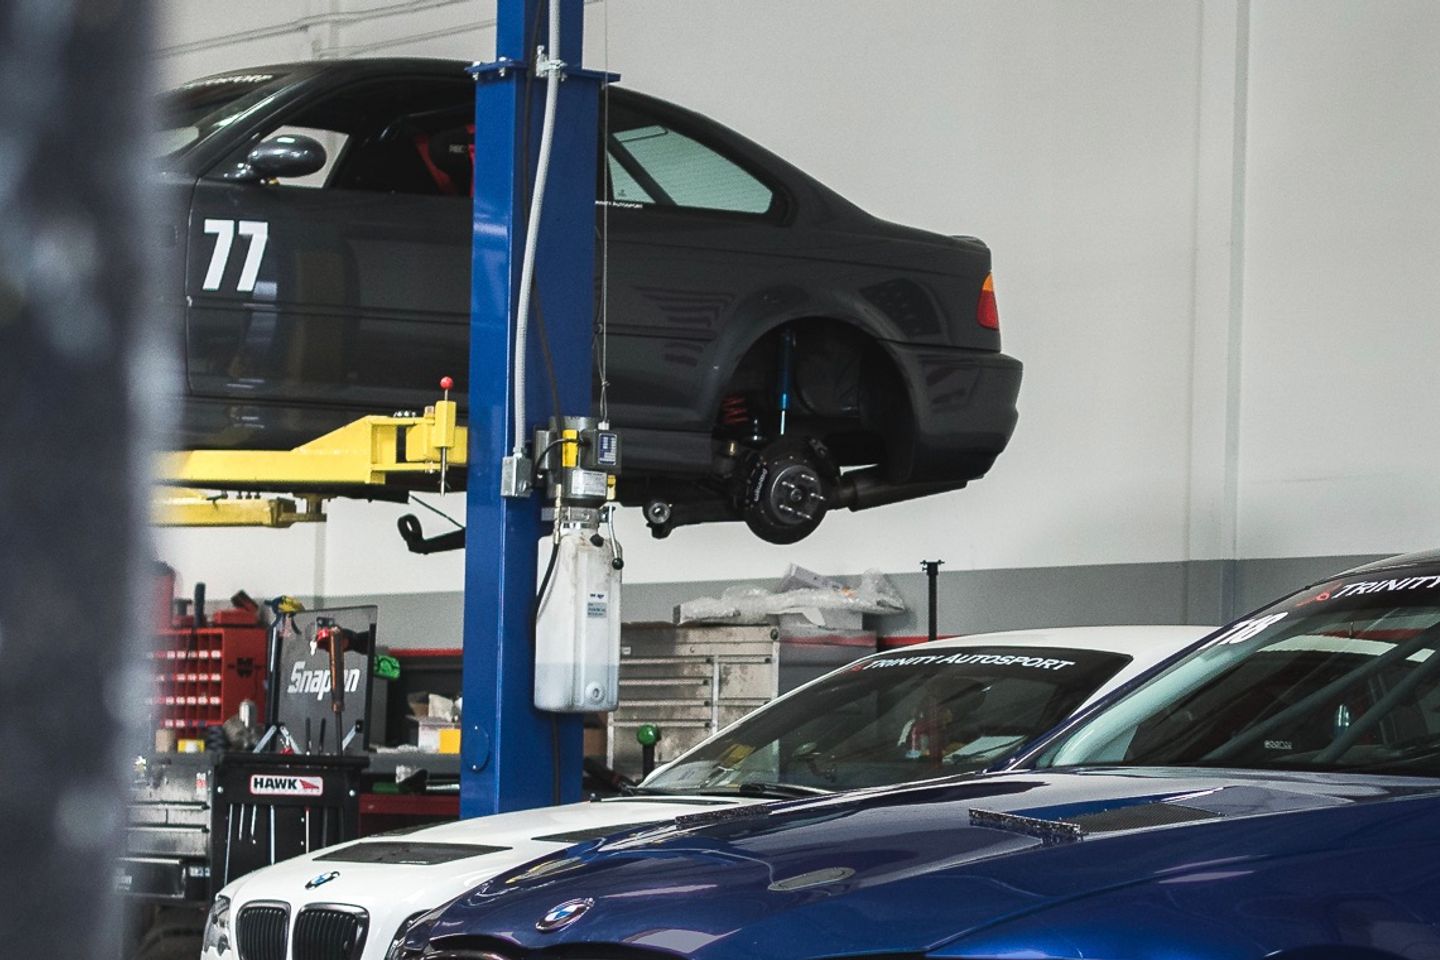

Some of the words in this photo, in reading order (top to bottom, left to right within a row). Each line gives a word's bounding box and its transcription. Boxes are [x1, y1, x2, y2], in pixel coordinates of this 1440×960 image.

[202, 218, 268, 292] 77
[863, 655, 945, 671] TRINITY
[941, 652, 1076, 671] AUTOSPORT
[253, 777, 298, 790] HAWK
